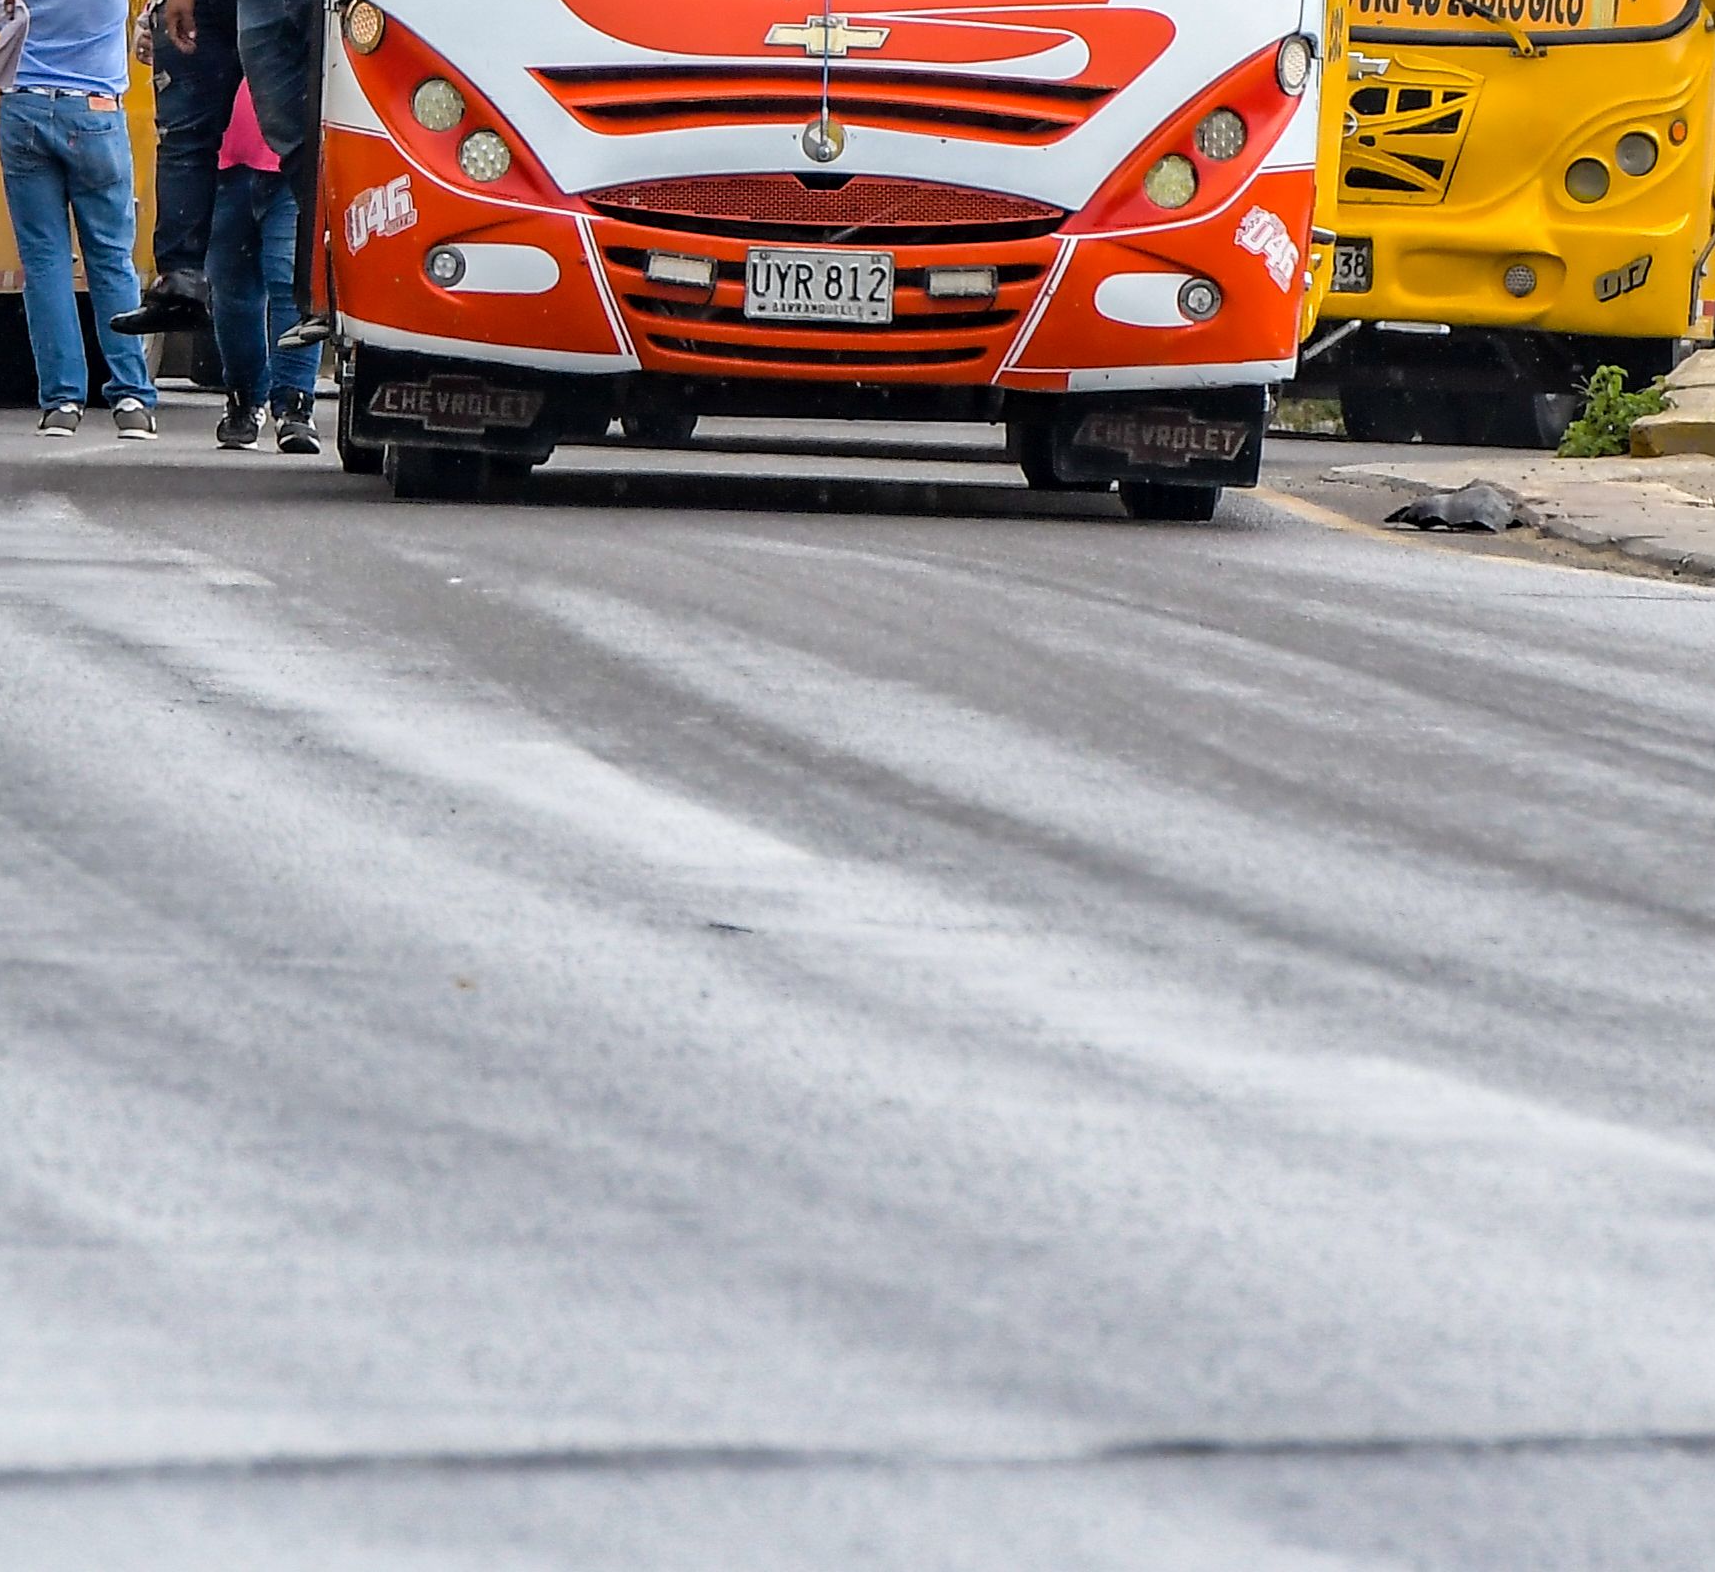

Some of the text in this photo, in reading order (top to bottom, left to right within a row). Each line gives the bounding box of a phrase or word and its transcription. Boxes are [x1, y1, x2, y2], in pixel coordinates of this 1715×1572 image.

[751, 261, 888, 304] UYR 812
[384, 387, 531, 419] CHEVROLET
[1089, 418, 1237, 452] CHEVROLET
